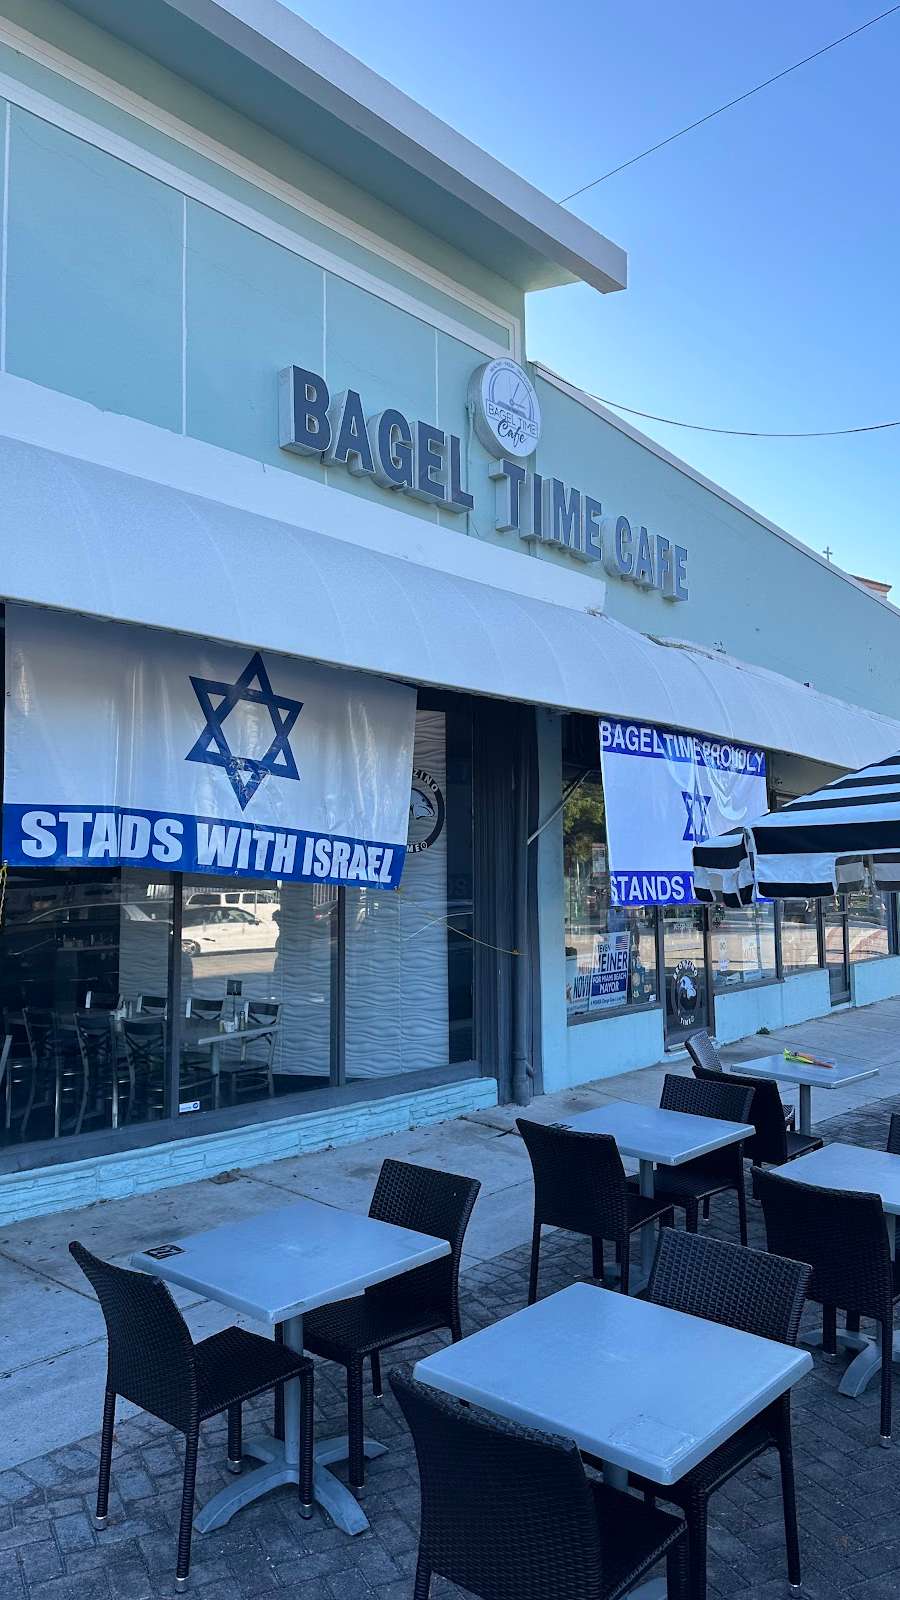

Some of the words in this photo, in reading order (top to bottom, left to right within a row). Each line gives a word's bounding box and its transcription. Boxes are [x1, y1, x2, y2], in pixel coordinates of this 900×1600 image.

[488, 403, 516, 426] BAGEL
[519, 418, 536, 435] TIME
[280, 364, 475, 513] BAGEL
[491, 459, 602, 562] TIME
[606, 515, 689, 601] CAFE
[599, 720, 664, 754] BAGEL
[412, 768, 439, 793] ZINO
[21, 810, 184, 864] STADS
[196, 822, 298, 874] WITH
[302, 837, 394, 883] ISRAEL
[610, 875, 685, 901] STANDS
[599, 980, 620, 994] MAYOR
